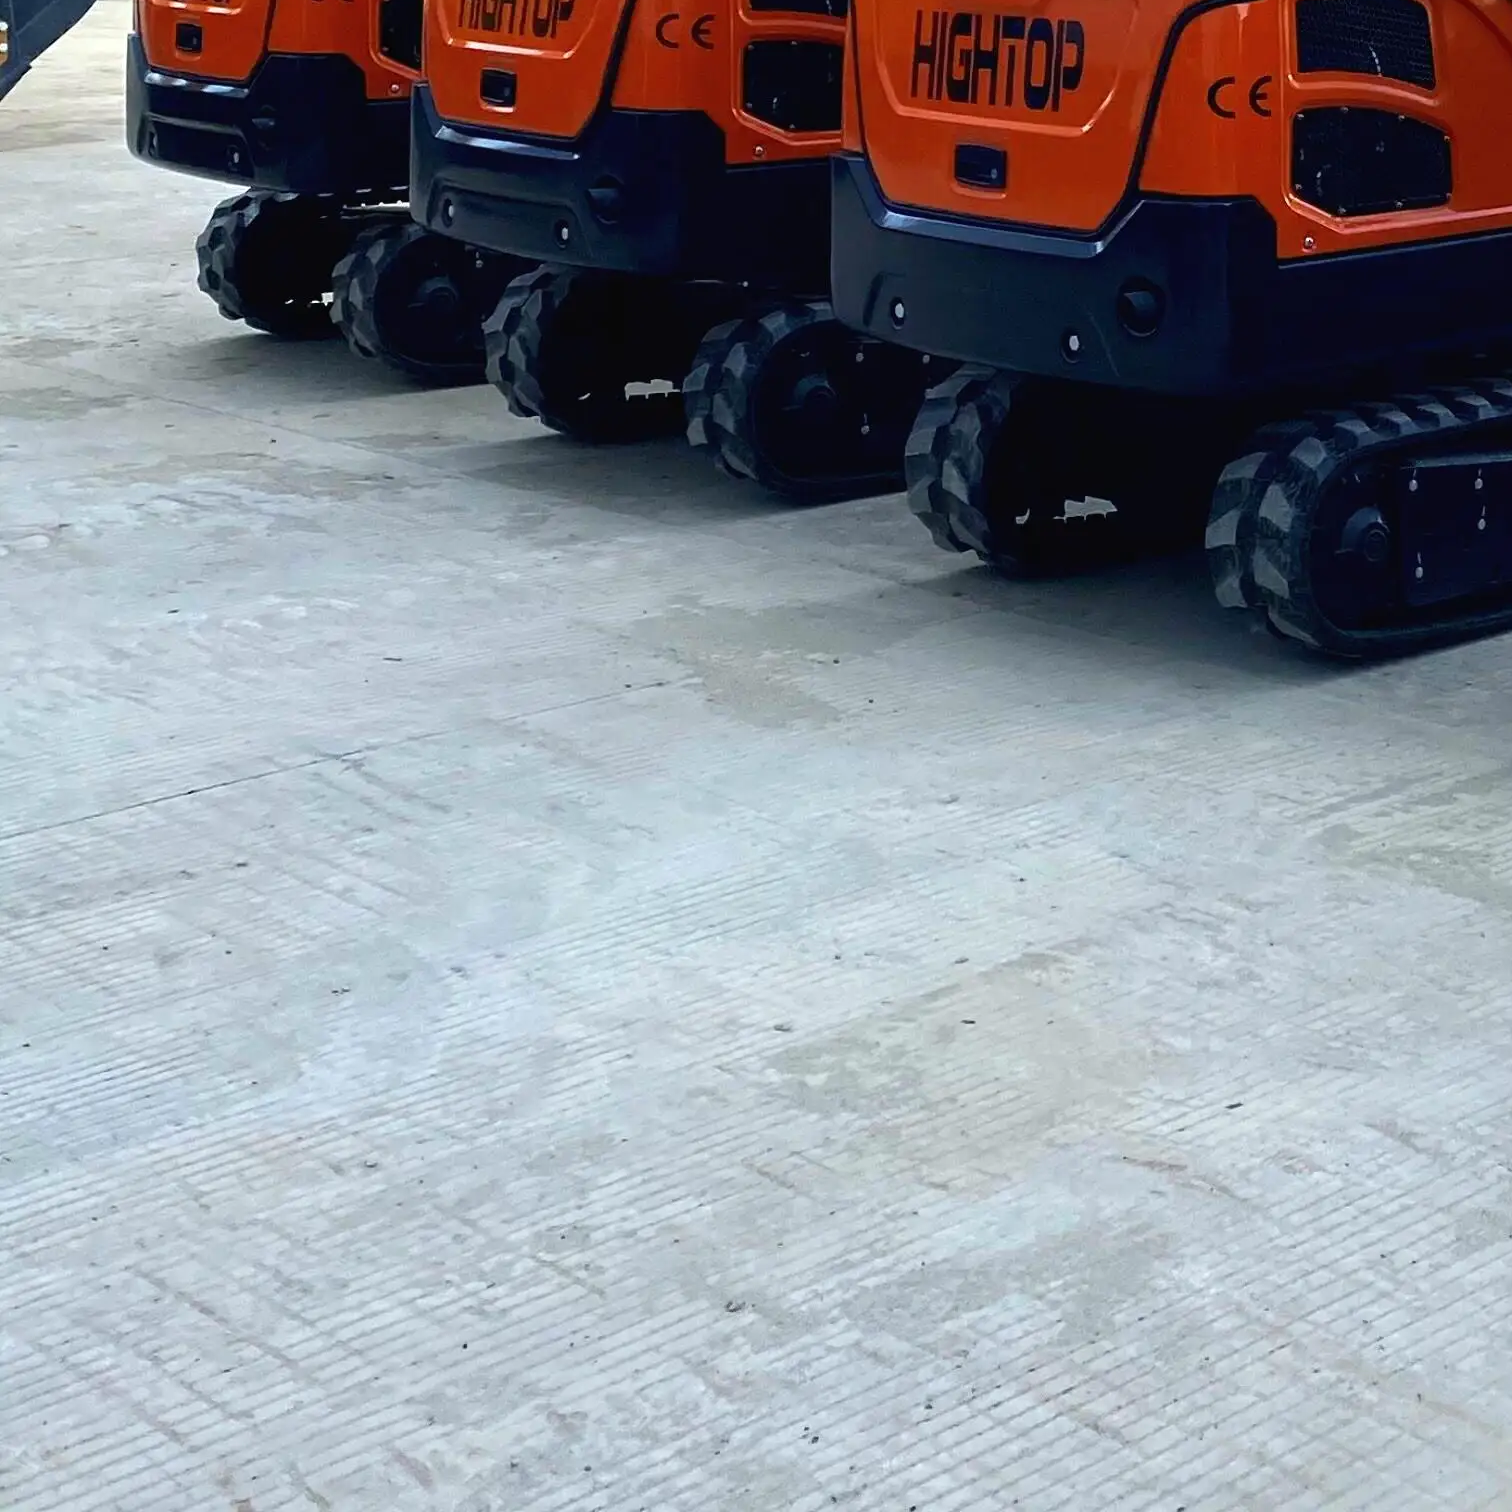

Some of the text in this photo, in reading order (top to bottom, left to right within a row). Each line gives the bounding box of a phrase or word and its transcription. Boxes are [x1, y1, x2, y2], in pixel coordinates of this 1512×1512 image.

[655, 13, 717, 51] CE
[910, 10, 1086, 113] HIGHTOP
[1206, 75, 1273, 119] CE
